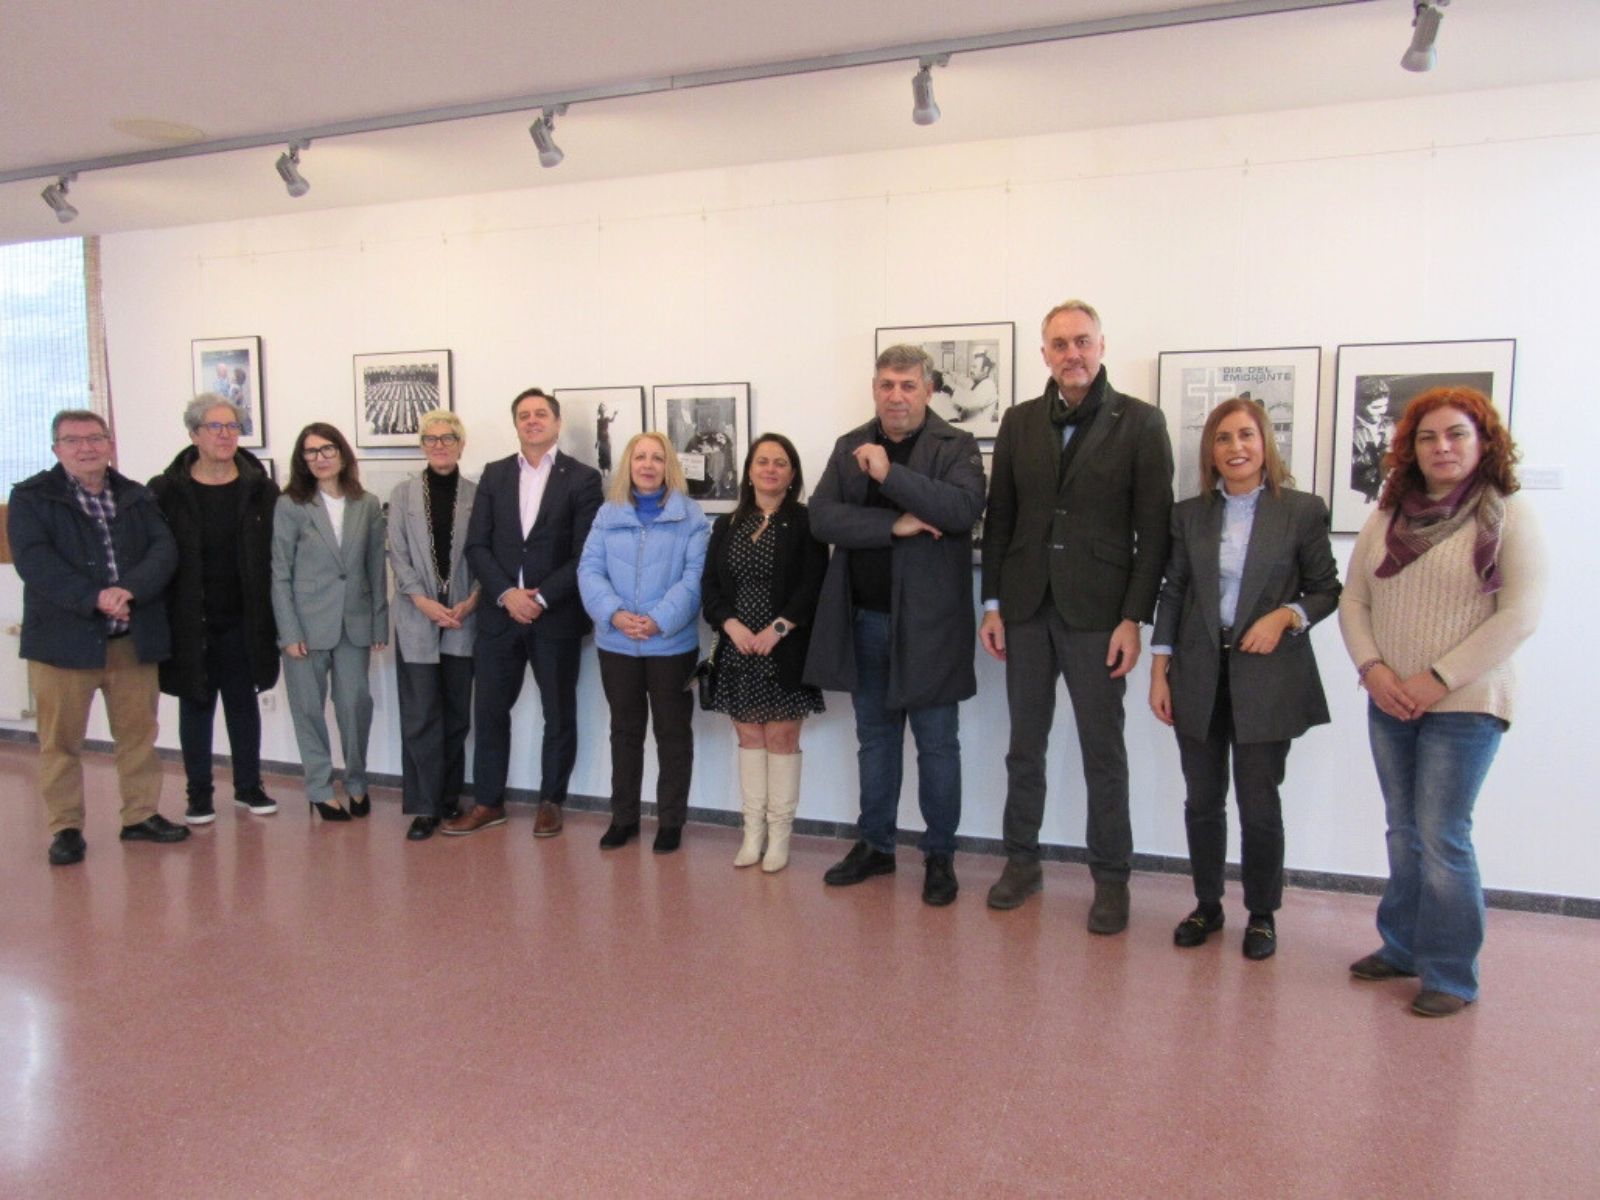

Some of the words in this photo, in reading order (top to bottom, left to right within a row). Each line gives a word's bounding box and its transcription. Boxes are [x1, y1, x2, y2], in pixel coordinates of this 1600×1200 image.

[1223, 366, 1242, 374] DIA
[1248, 366, 1271, 374] DEL
[1223, 372, 1292, 382] EMIGRANTE
